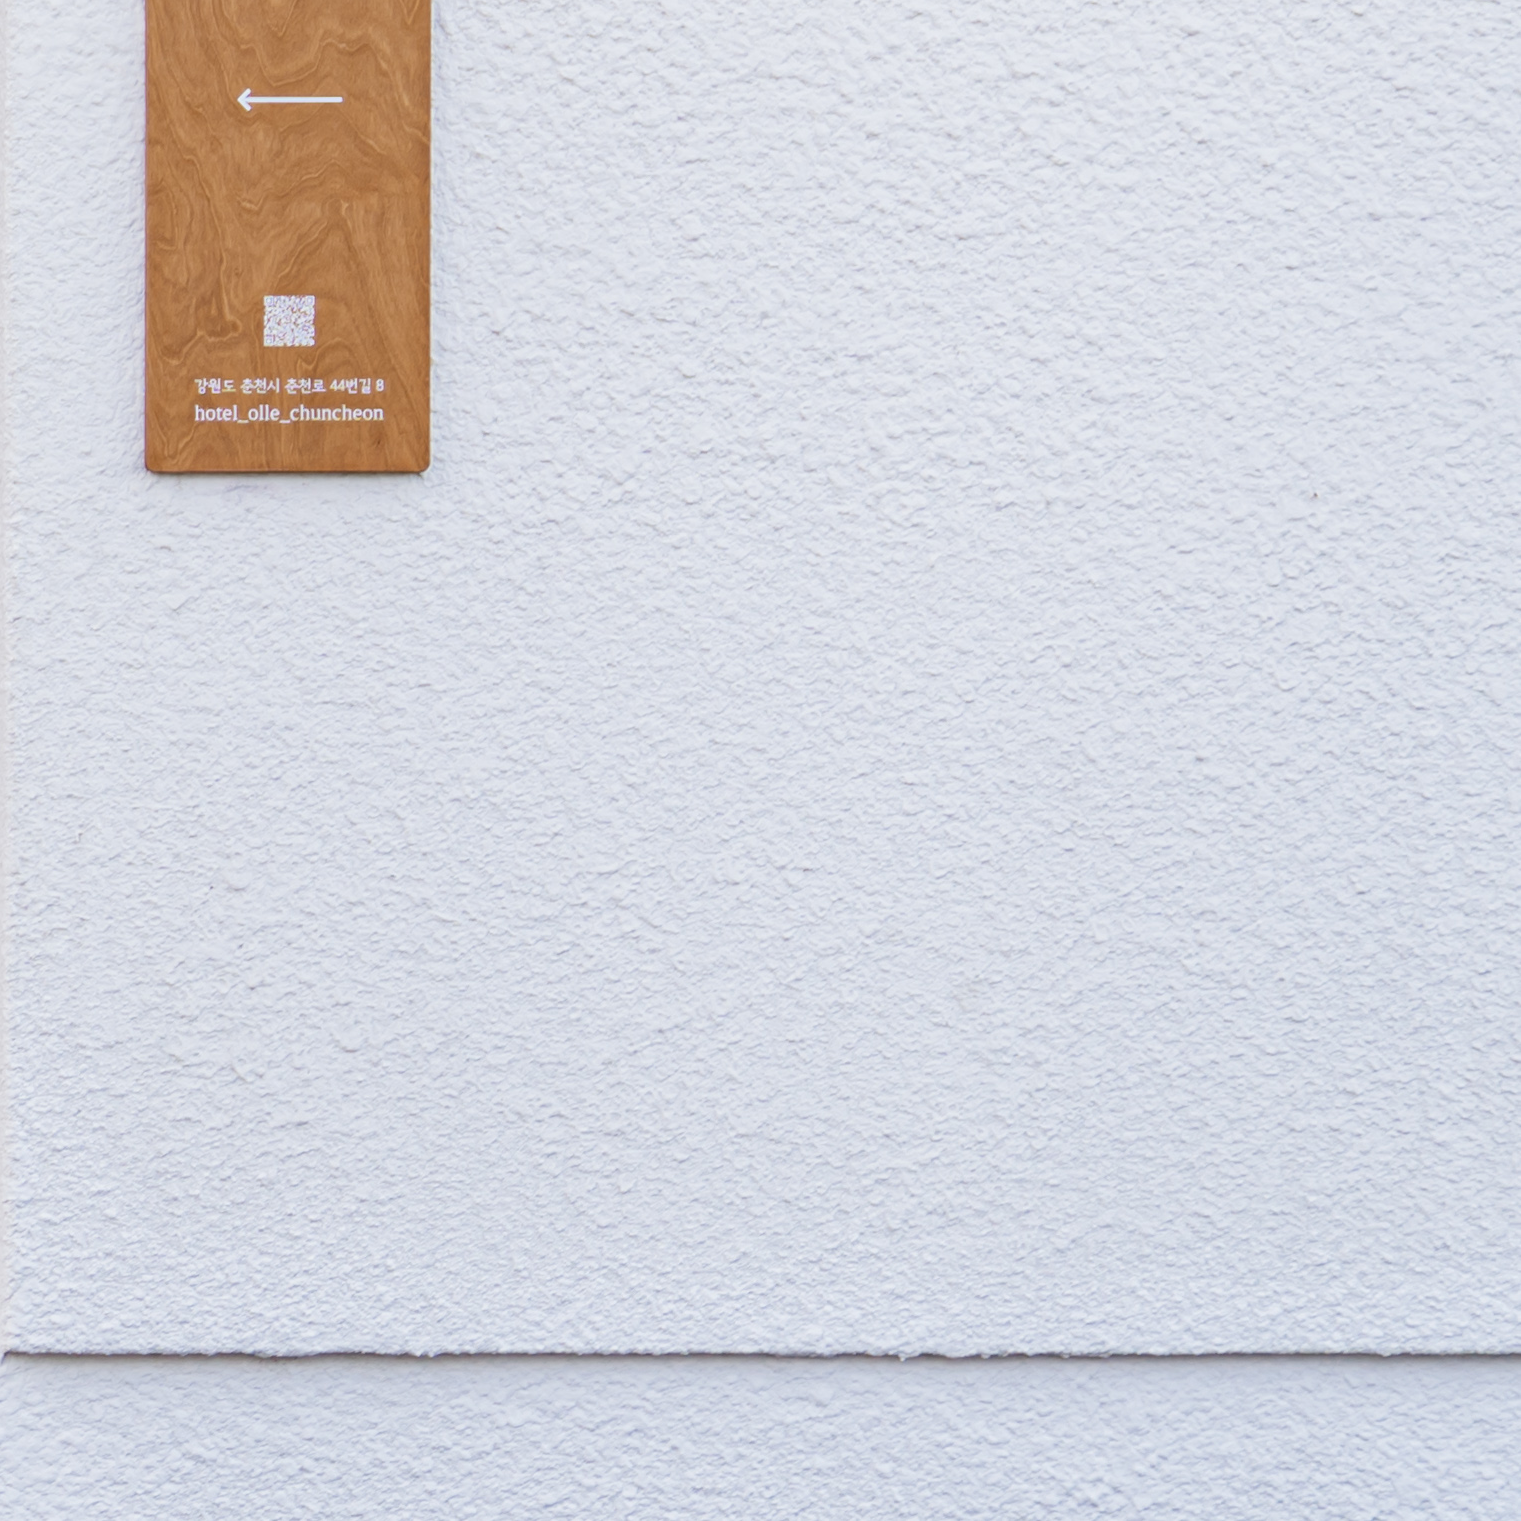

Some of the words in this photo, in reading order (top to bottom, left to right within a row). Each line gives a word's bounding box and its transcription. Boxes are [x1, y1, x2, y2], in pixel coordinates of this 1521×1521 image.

[194, 377, 236, 395] 강원도
[240, 377, 281, 395] 춘천시
[284, 377, 327, 395] 춘천로
[329, 377, 372, 395] 44번길
[376, 378, 385, 392] 8
[194, 403, 384, 424] hotel_olle_chuncheon
